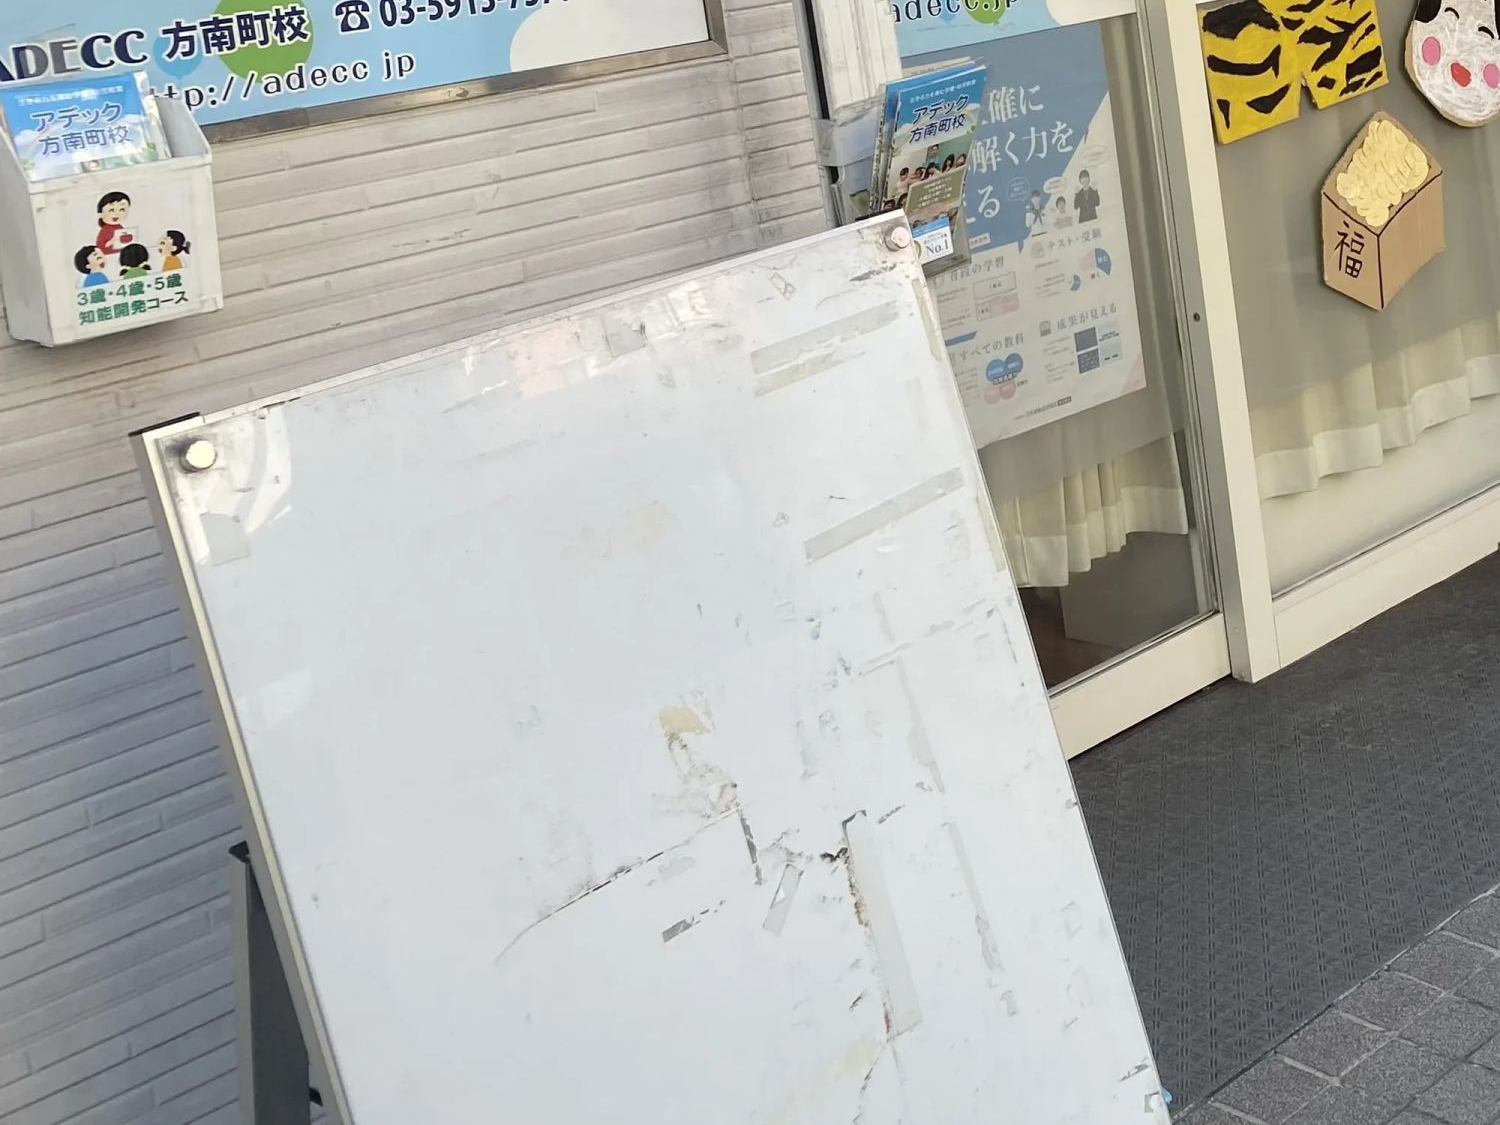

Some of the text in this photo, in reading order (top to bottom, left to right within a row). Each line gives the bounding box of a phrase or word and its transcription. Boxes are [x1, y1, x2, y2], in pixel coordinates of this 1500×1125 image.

[162, 6, 309, 59] 方南町校
[31, 102, 122, 132] アデック
[913, 94, 969, 124] アデック
[981, 85, 1044, 125] 確に
[38, 125, 132, 155] 方南町校
[909, 114, 966, 143] 方南町校
[1334, 220, 1365, 279] 福
[79, 291, 189, 325] 知能開発コース
